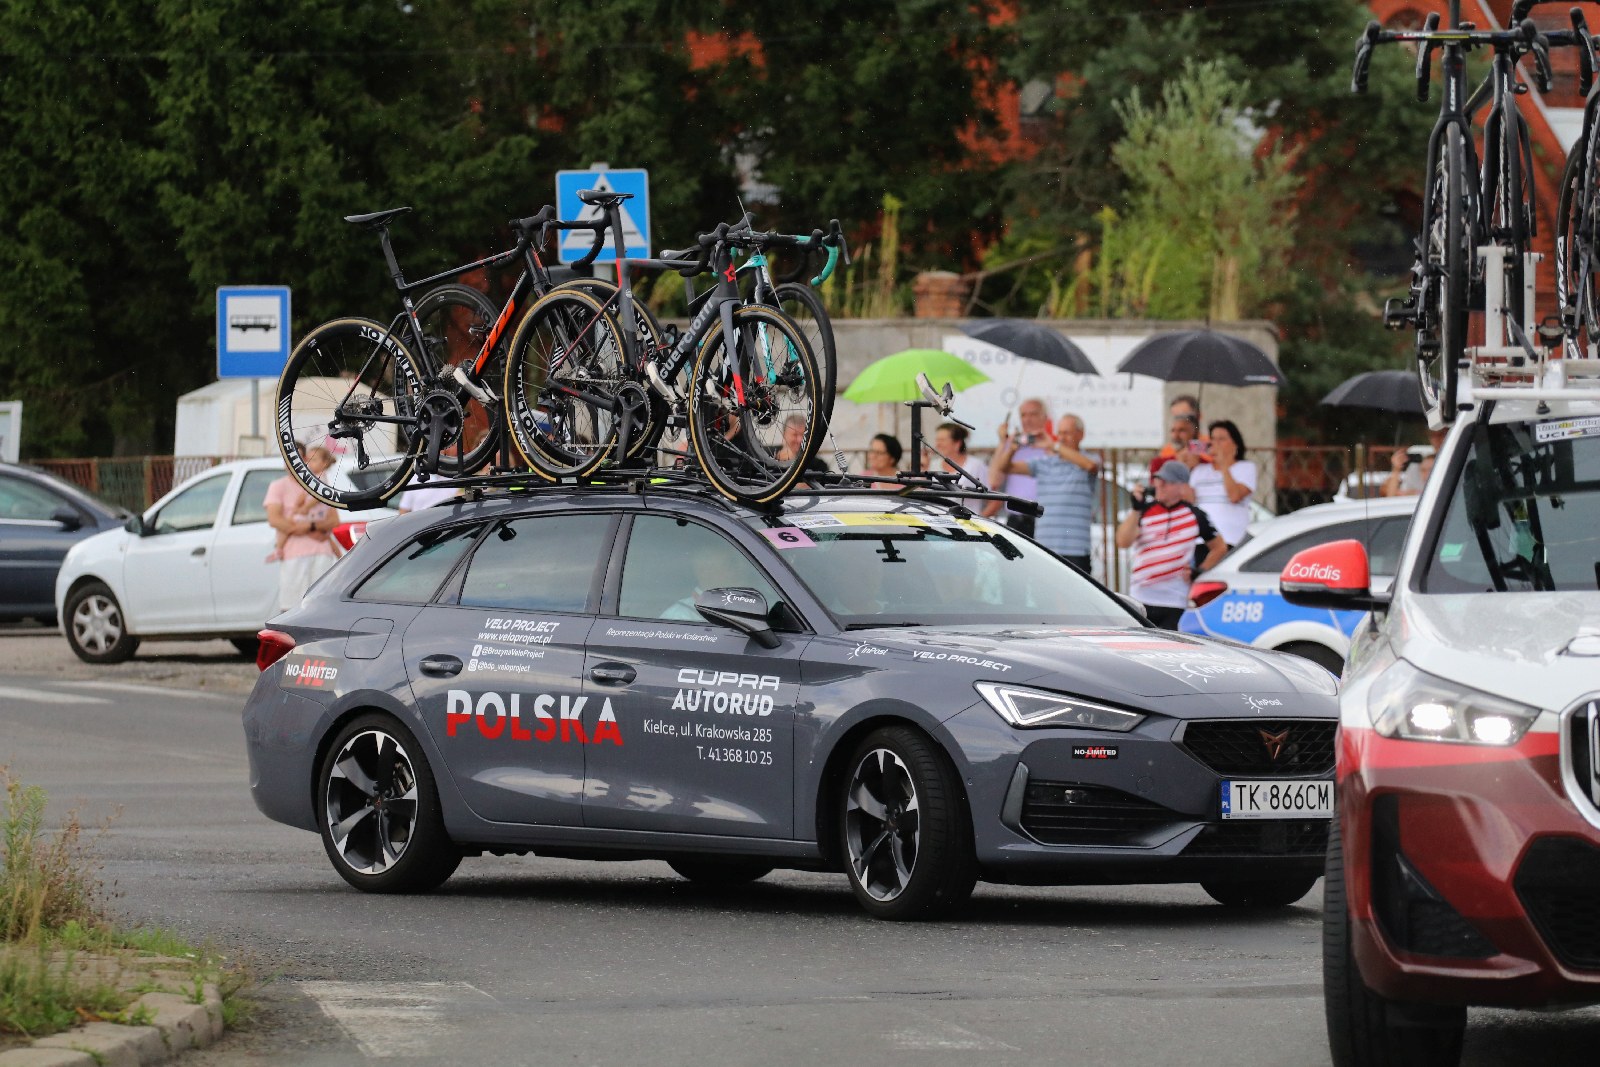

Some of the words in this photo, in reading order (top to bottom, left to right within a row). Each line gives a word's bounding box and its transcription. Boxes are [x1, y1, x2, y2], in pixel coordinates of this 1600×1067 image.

[1539, 431, 1565, 440] UCI
[777, 531, 799, 542] 6
[1290, 563, 1341, 580] Cofidis
[1221, 601, 1264, 623] B818
[484, 617, 513, 630] VELO
[511, 619, 560, 633] PROJECT
[478, 631, 553, 646] www.veloproject.pl
[861, 646, 889, 656] InPost
[912, 650, 947, 660] VELO
[948, 654, 1012, 673] PROJECT
[285, 663, 338, 680] NO-LIMITED
[677, 668, 781, 691] CUPRA
[671, 689, 774, 717] AUTORUD
[446, 689, 624, 746] POLSKA
[643, 719, 678, 738] Kielce,
[680, 722, 693, 736] ul.
[695, 723, 751, 741] Krakowska
[752, 727, 772, 743] 285
[696, 746, 706, 760] T.
[708, 747, 720, 761] 41
[722, 748, 742, 763] 368
[744, 750, 758, 764] 10
[759, 752, 773, 765] 25
[1074, 748, 1117, 756] NO-LIMITED
[1222, 801, 1230, 809] PL
[1235, 784, 1260, 810] TK
[1269, 784, 1329, 810] 866CM
